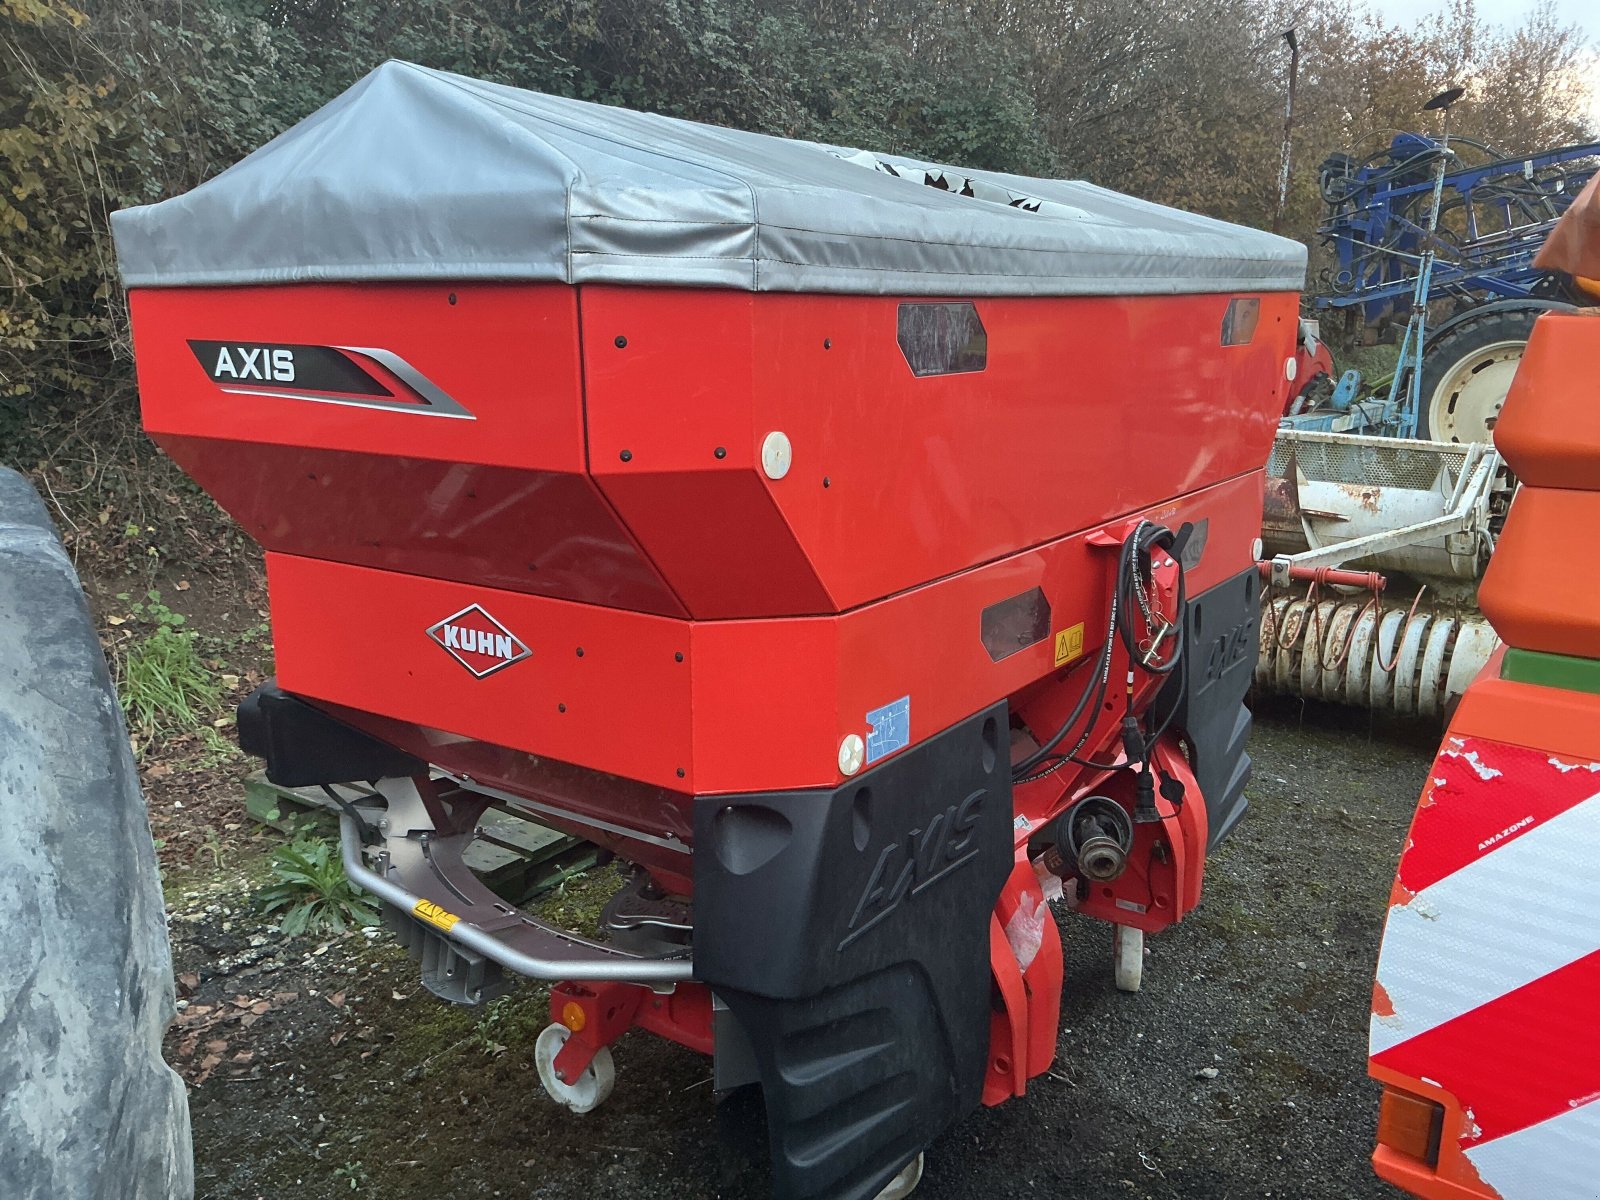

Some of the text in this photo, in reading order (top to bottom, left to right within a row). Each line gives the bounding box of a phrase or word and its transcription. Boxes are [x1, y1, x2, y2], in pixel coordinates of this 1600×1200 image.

[214, 346, 295, 382] AXIS
[443, 624, 513, 660] KUHN
[1204, 618, 1253, 680] AXIS
[1478, 815, 1535, 851] AMAZONE
[848, 788, 989, 929] AXIS
